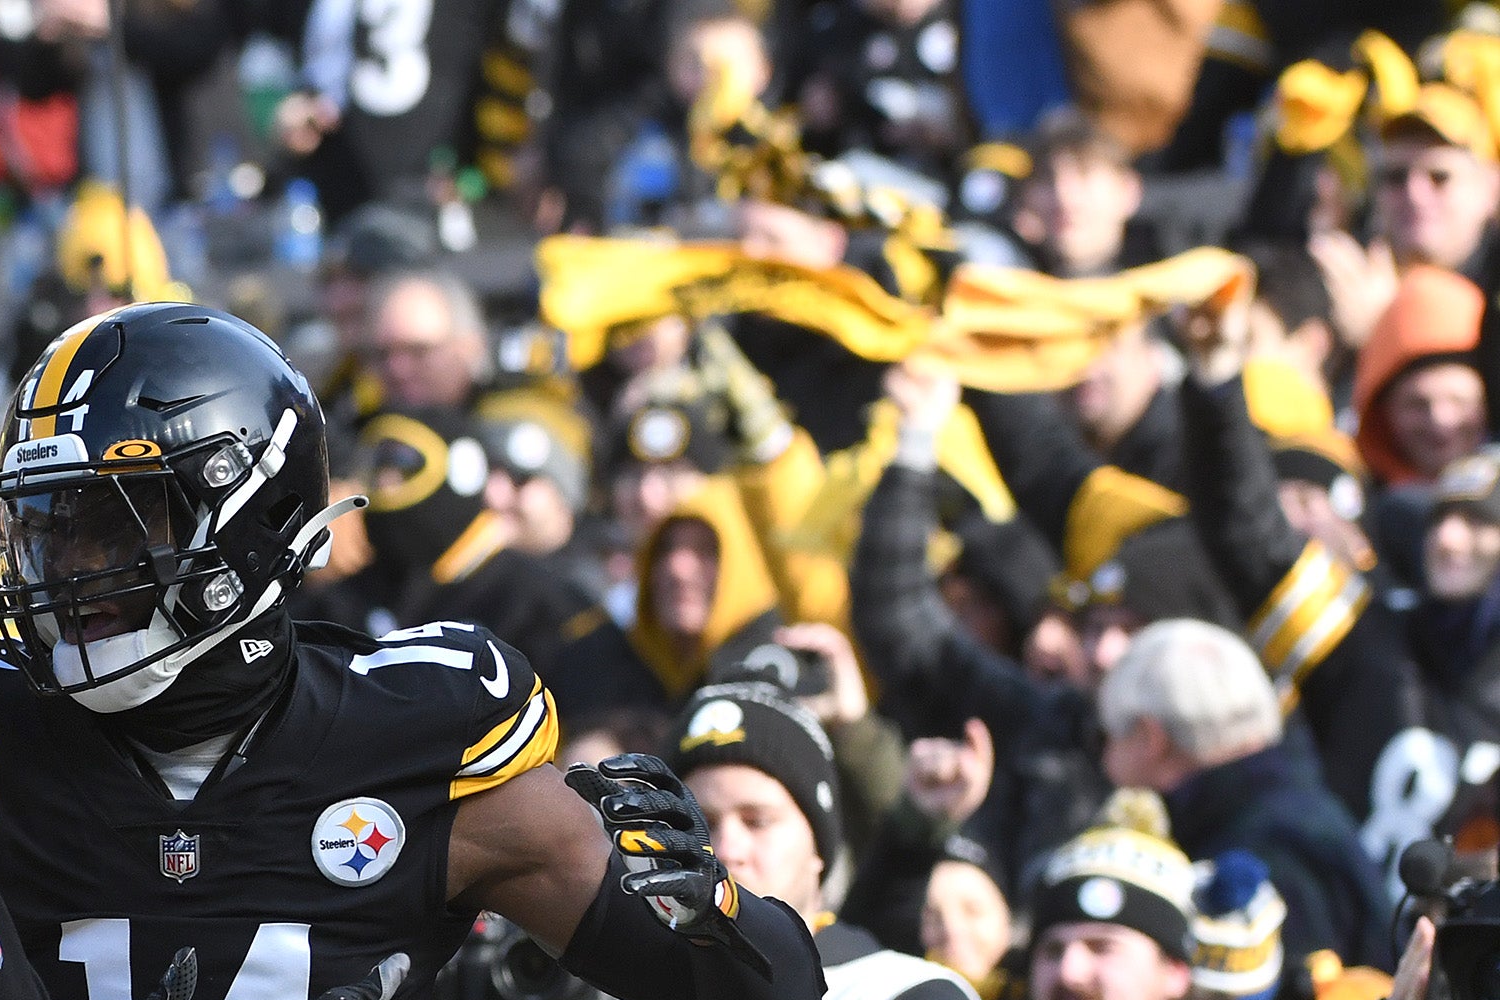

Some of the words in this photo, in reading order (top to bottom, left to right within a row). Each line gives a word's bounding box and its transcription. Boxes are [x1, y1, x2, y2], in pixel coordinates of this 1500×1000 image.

[16, 443, 58, 464] Steelers
[319, 838, 356, 851] Steelers
[165, 853, 195, 875] NFL
